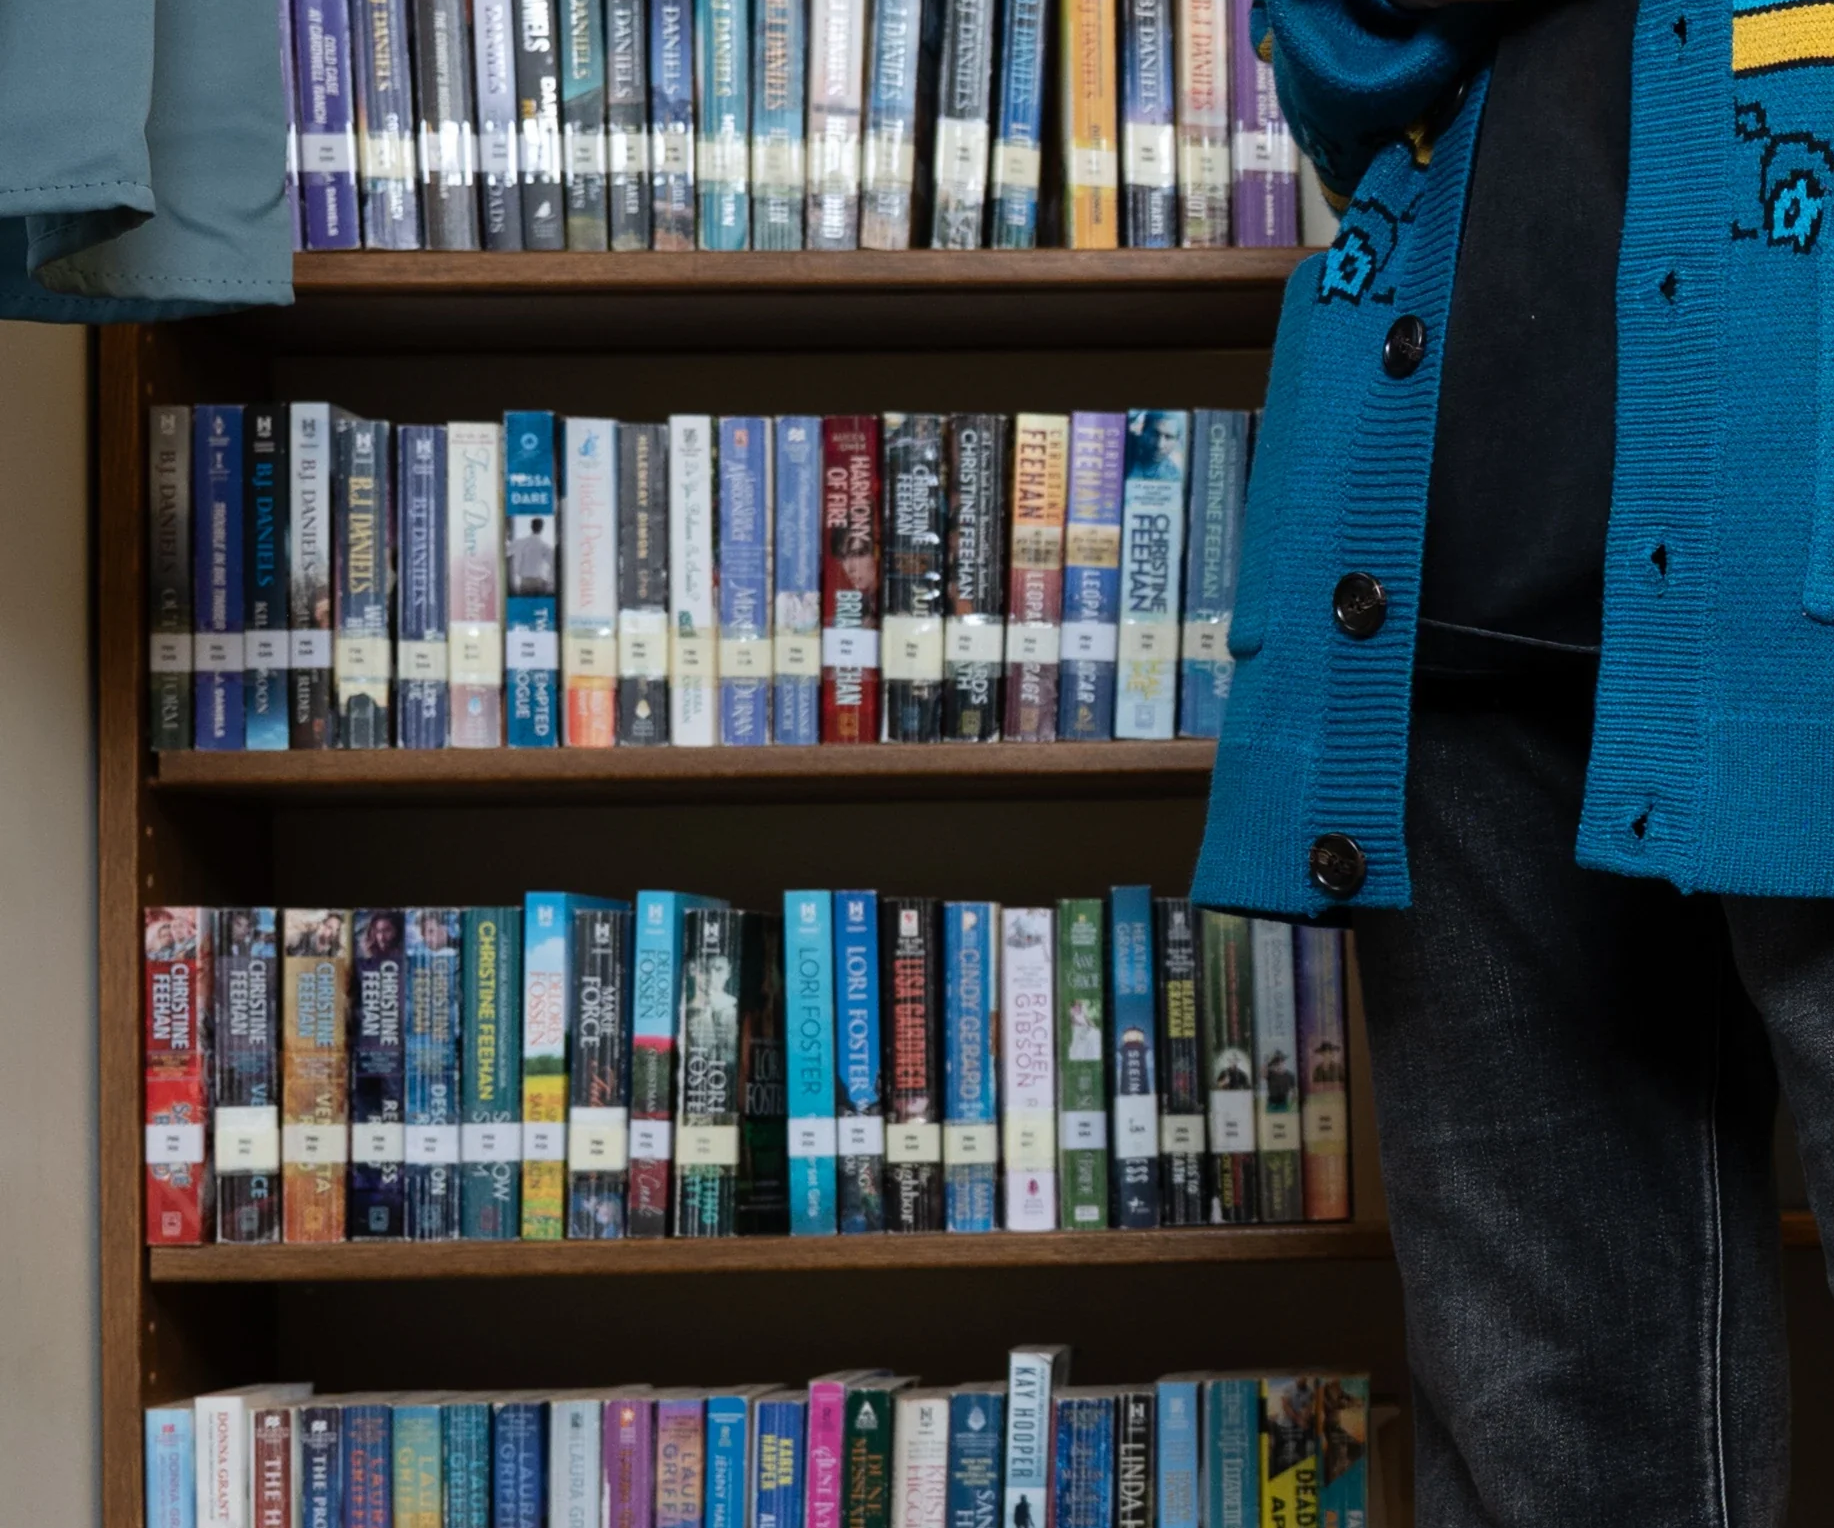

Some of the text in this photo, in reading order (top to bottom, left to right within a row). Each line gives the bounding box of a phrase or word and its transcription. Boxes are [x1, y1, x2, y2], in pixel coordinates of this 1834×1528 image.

[613, 10, 633, 99] DANIELS
[661, 6, 681, 95] DANIELS
[1139, 27, 1158, 114] DANIELS
[300, 489, 316, 572] DANIELS
[826, 467, 848, 528] OF FIRE
[849, 456, 871, 541] HARMONY
[958, 428, 978, 600] CHRISTINE FEEHAN
[256, 497, 274, 588] DANIELS
[349, 512, 374, 594] DANIELS
[578, 473, 604, 609] Jude Deveraux
[296, 675, 311, 724] RIDES
[1021, 663, 1041, 704] RAGE
[152, 974, 171, 1039] FEEHAN
[171, 963, 190, 1049] CHRISTINE
[477, 921, 497, 1100] CHRISTINE FEEHAN
[528, 971, 545, 1046] FOSSEN
[546, 972, 561, 1045] DELORES
[580, 976, 600, 1049] FORCE
[599, 986, 615, 1036] MARIE
[799, 947, 821, 1095] LORI FOSTER
[894, 958, 924, 1089] LISA GARDNER
[959, 949, 979, 1100] CINDY GERARD
[1015, 994, 1031, 1088] GIBSON
[1031, 994, 1048, 1085] RACHEL
[1167, 980, 1181, 1038] GRAHAM
[1181, 980, 1195, 1038] HEATHER
[761, 1434, 776, 1491] HARPER
[778, 1438, 794, 1485] KAREN
[1010, 1366, 1038, 1479] KAY HOOPER
[216, 1411, 230, 1520] DONNA GRANT
[264, 1457, 281, 1500] THE
[312, 1454, 327, 1491] THE
[714, 1453, 728, 1499] JENNY
[866, 1453, 884, 1517] DUNE
